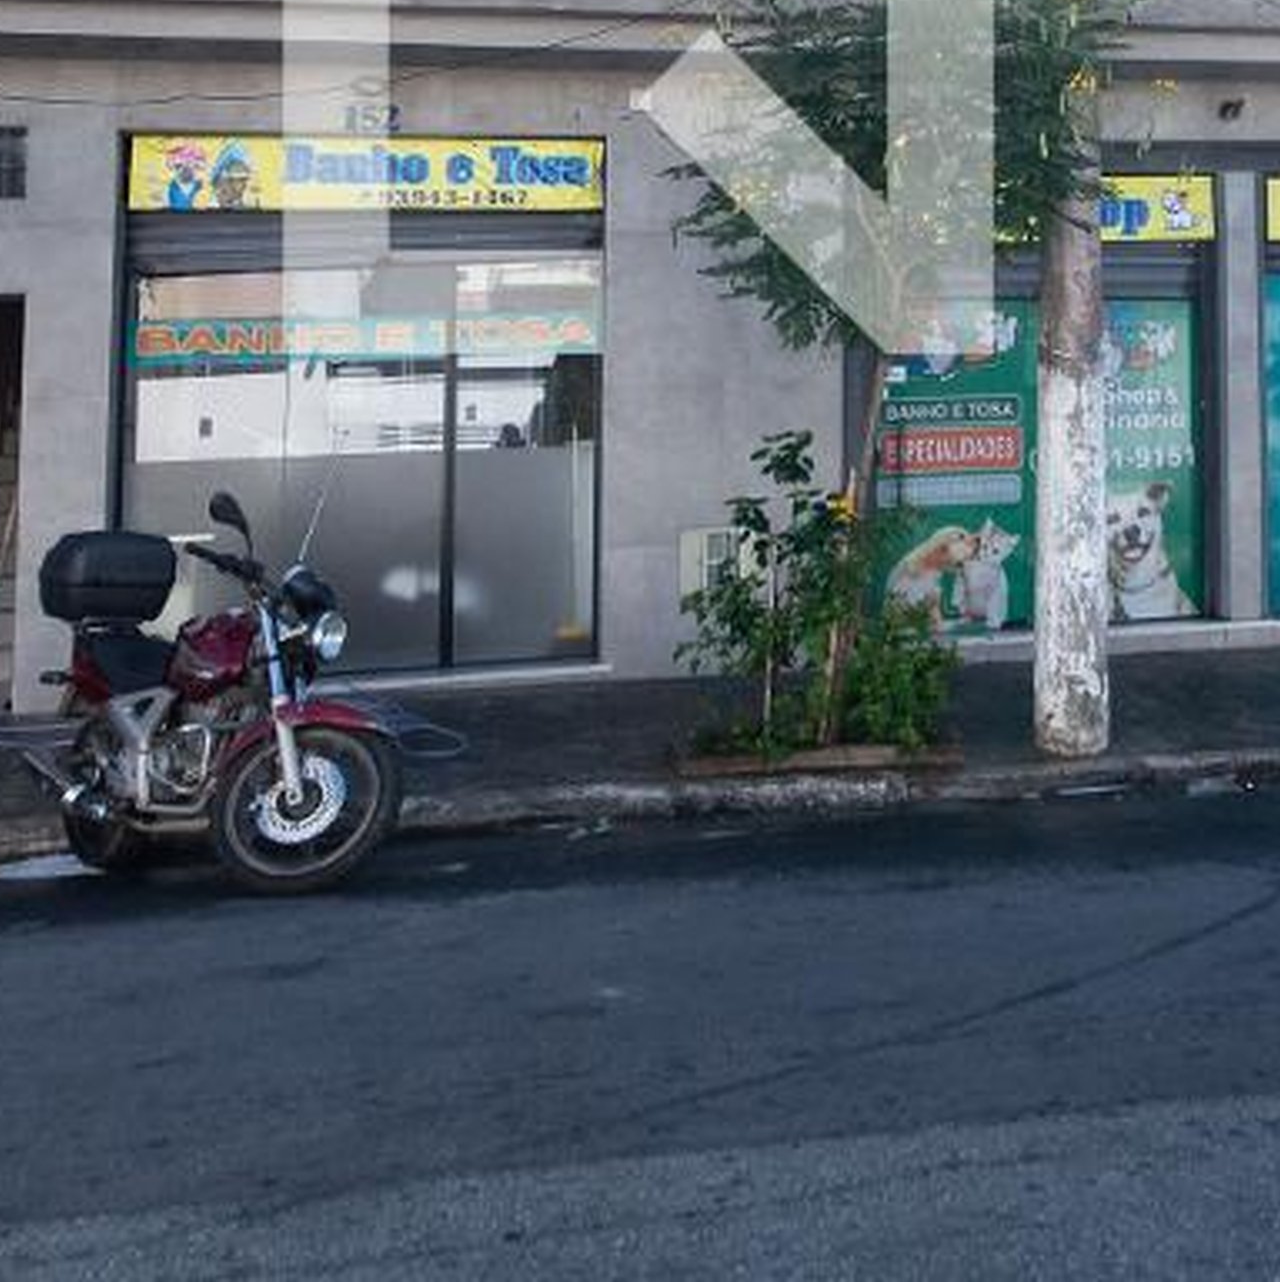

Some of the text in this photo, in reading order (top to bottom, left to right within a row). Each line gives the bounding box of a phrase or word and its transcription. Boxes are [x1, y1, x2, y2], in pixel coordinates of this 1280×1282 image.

[344, 104, 401, 132] 152
[285, 144, 429, 184] Banho
[490, 146, 590, 186] Tosa
[136, 322, 354, 355] BANHO
[888, 435, 1016, 464] EPECIALIDADES
